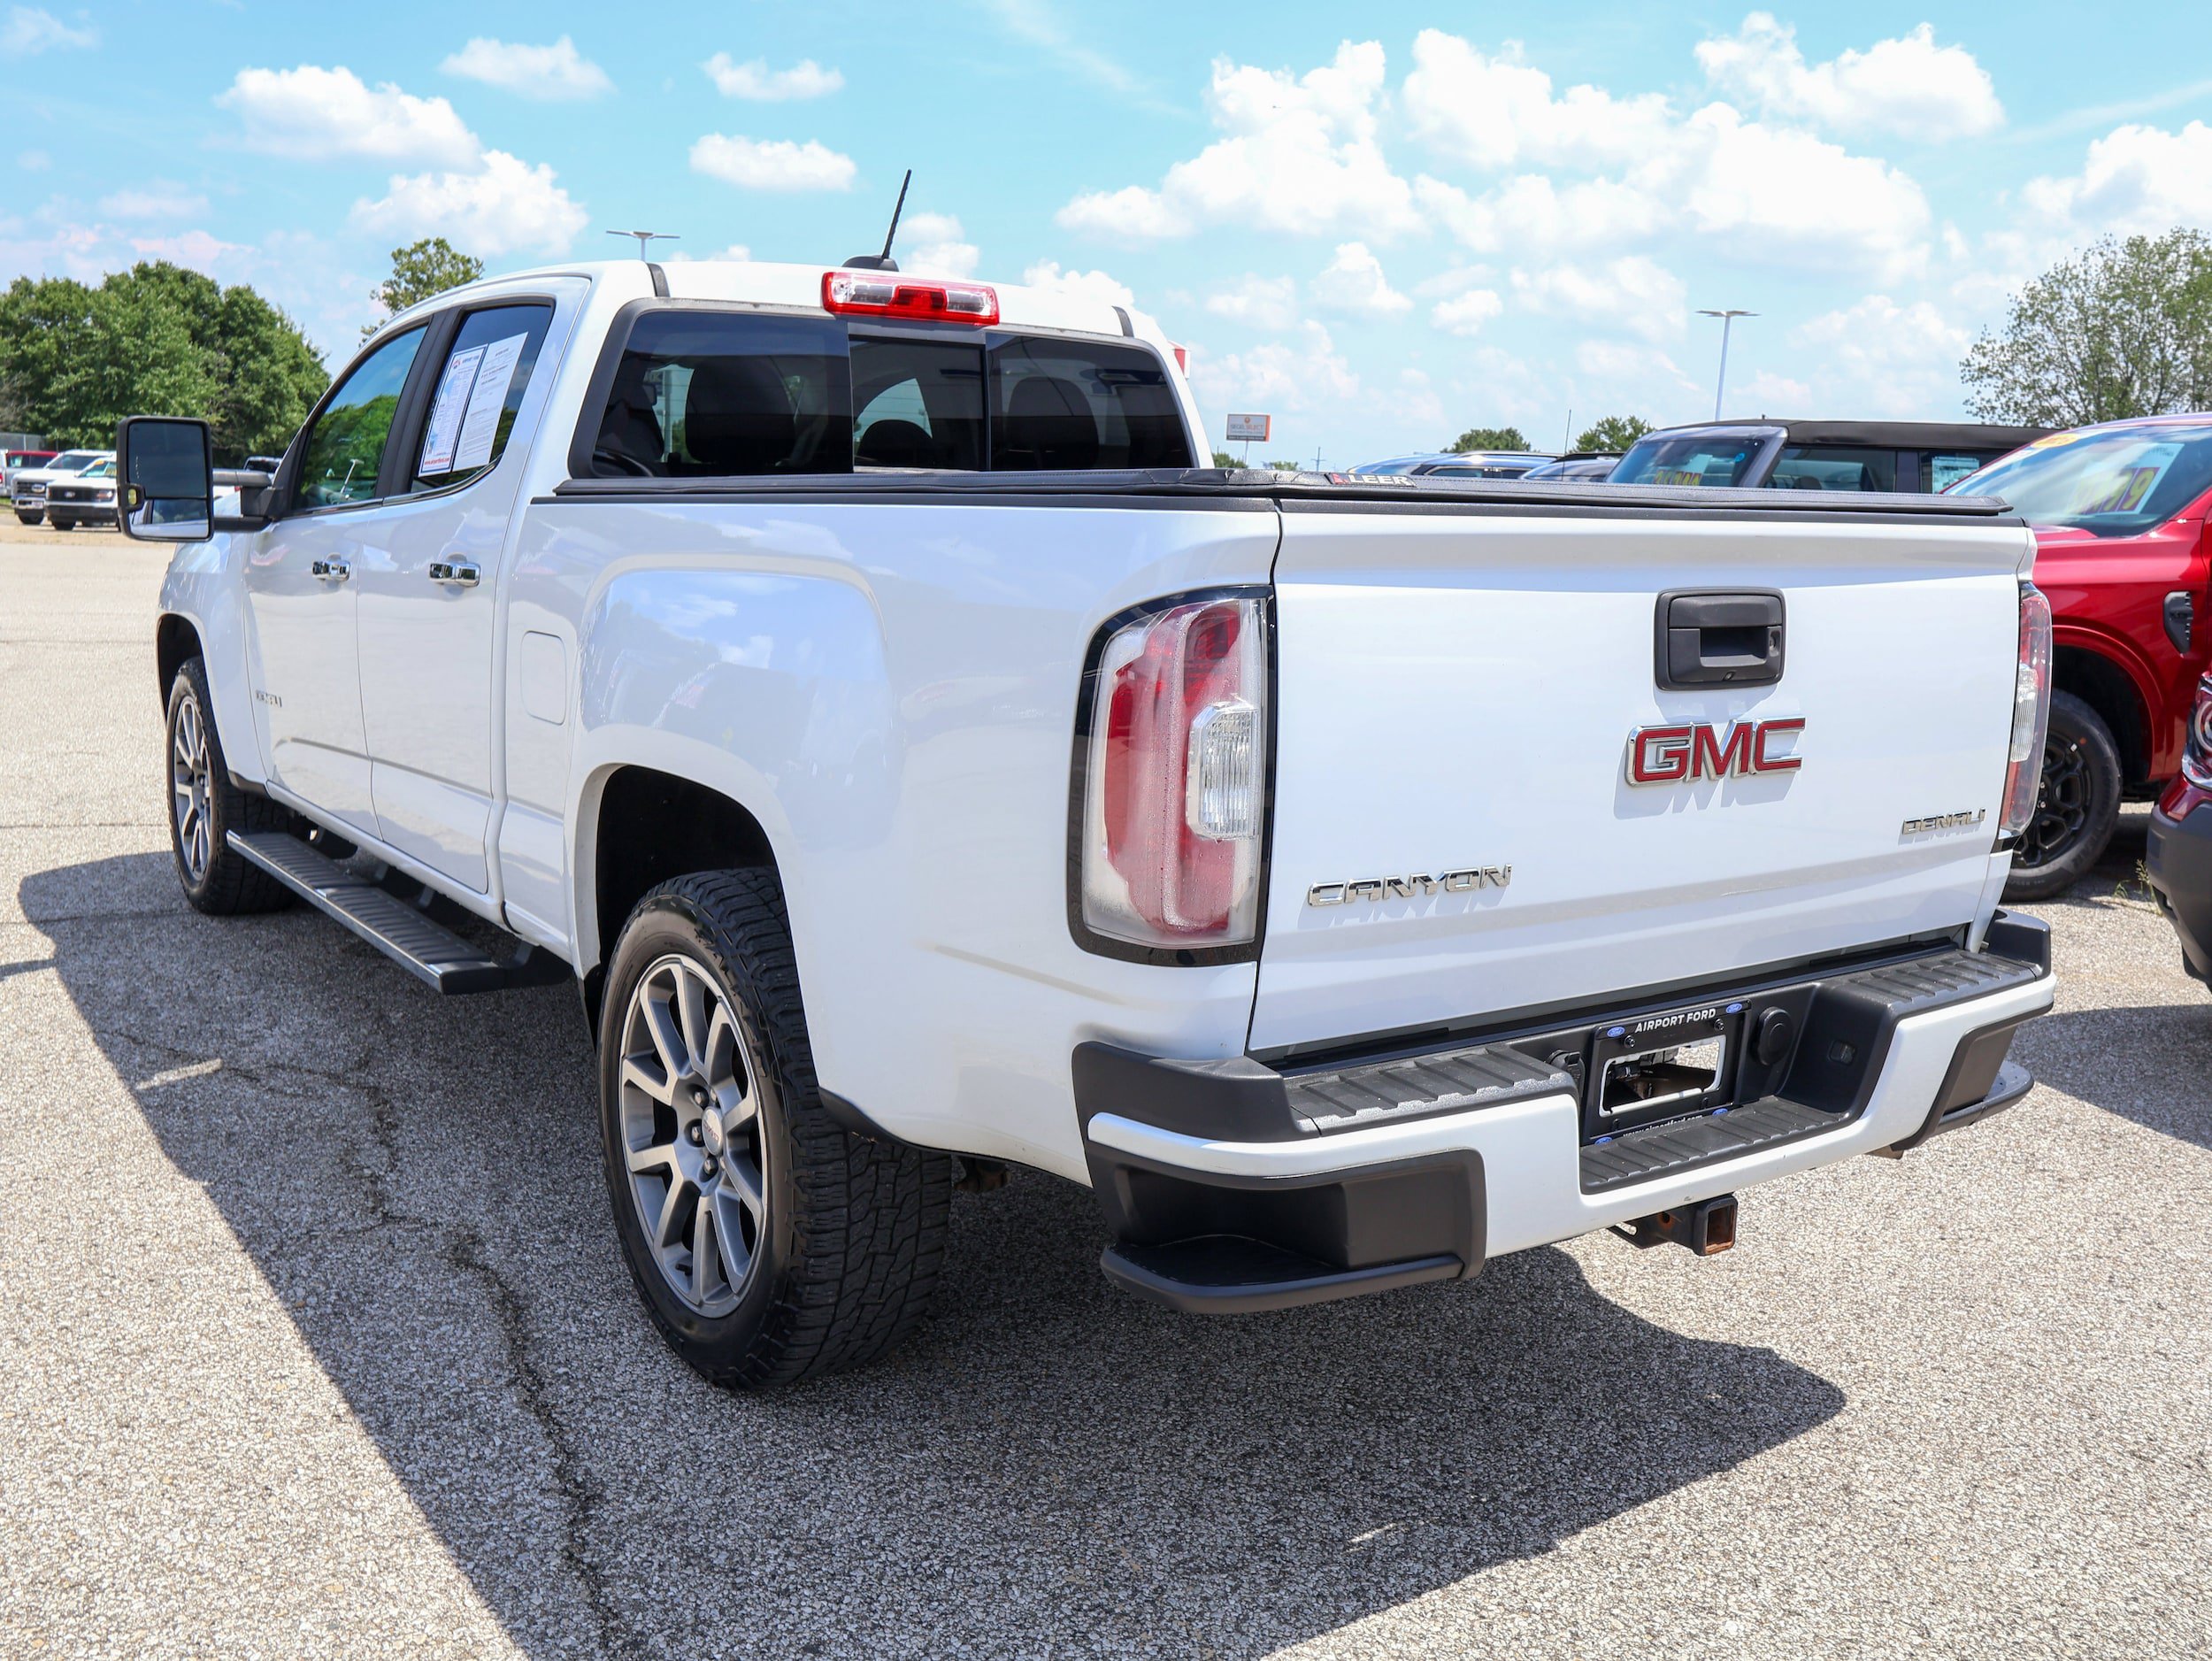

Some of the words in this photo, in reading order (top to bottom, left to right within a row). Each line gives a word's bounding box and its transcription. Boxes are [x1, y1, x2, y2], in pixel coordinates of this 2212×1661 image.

[1348, 473, 1414, 486] LEER
[1624, 718, 1806, 786] GMC
[1902, 808, 1985, 834] DENALI
[1308, 864, 1512, 906] CANYON
[1635, 1015, 1685, 1034] AIRPORT
[1686, 1008, 1717, 1024] FORD
